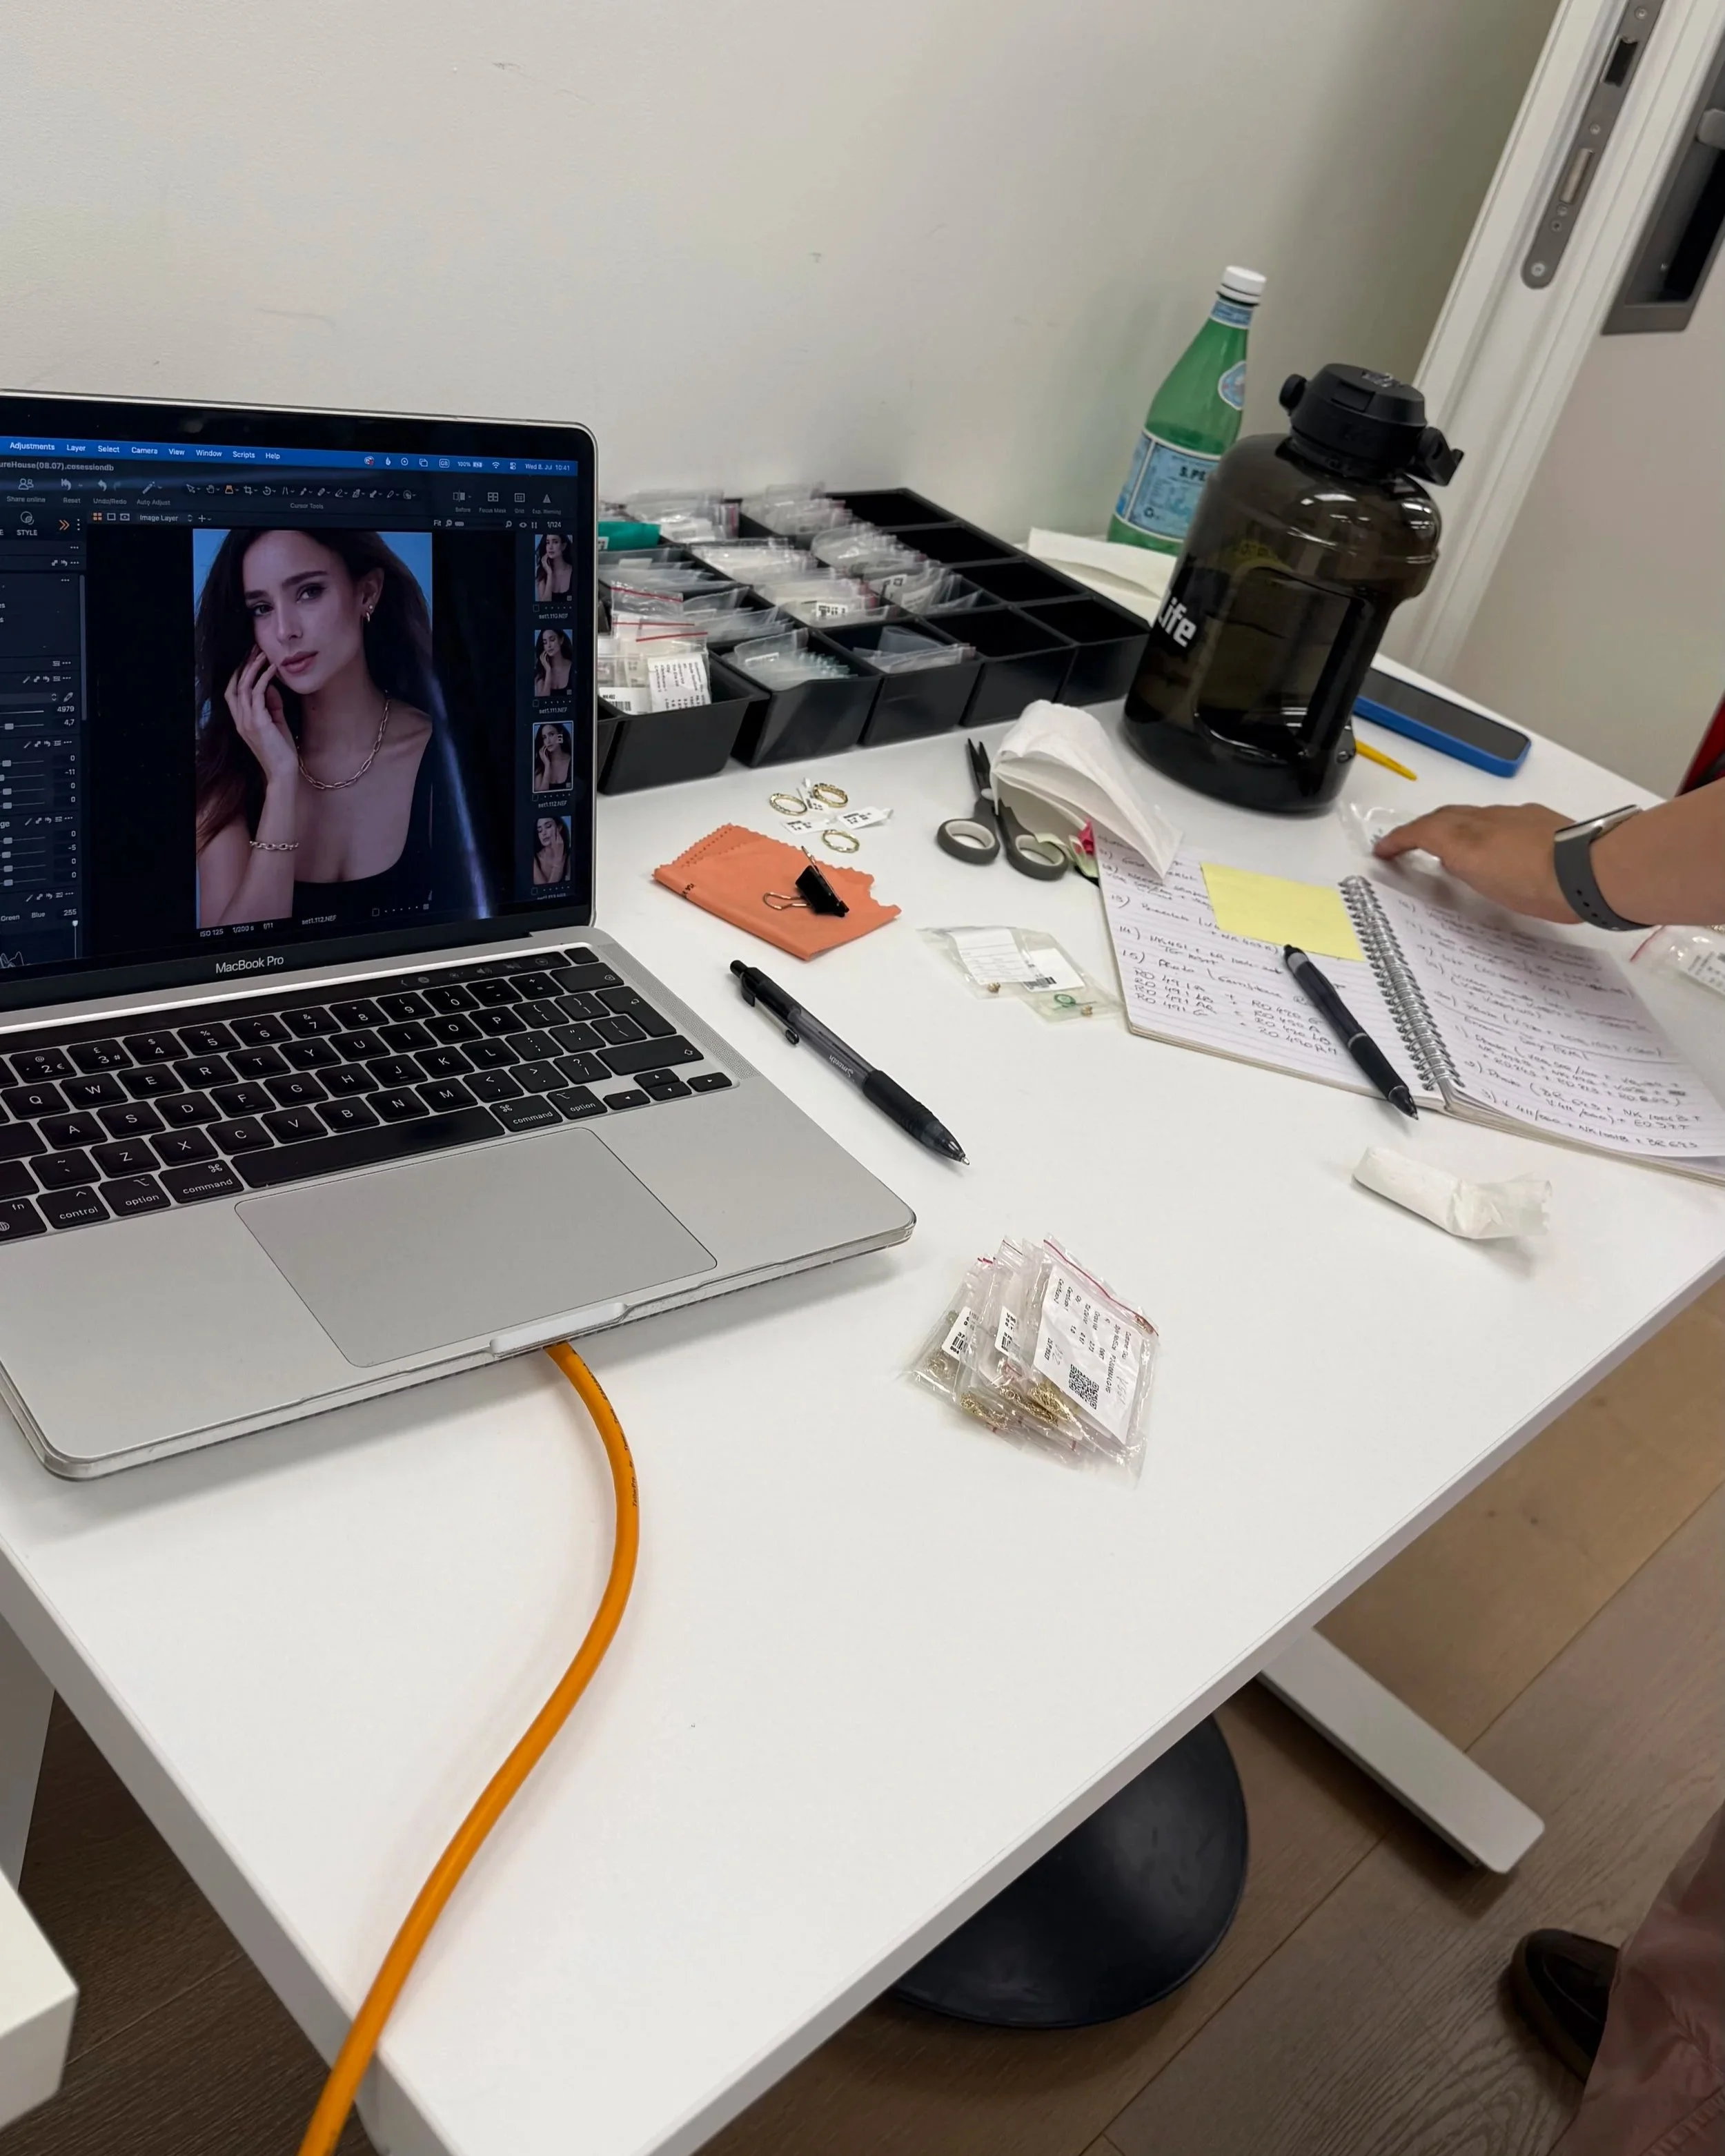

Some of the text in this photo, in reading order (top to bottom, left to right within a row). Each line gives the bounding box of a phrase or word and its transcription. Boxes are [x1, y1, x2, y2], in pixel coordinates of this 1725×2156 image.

[10, 442, 55, 451] Adjustments
[98, 445, 119, 453] Select
[131, 447, 158, 455] Camera
[233, 451, 255, 459] Scripts
[266, 452, 280, 460] Help
[215, 955, 284, 974] MacBook Pro
[208, 1038, 217, 1046] 5
[259, 1030, 270, 1038] 6
[29, 1095, 43, 1105] Q
[85, 1085, 101, 1095] W
[145, 1077, 157, 1086] E
[199, 1067, 212, 1075] R
[253, 1057, 263, 1066] T
[353, 1041, 366, 1049] U
[492, 1017, 501, 1025] P
[41, 1064, 52, 1073] 2
[99, 1055, 110, 1064] 3
[829, 1055, 854, 1078] Smooth
[69, 1125, 80, 1135] A
[126, 1115, 137, 1124] S
[181, 1104, 194, 1113] D
[237, 1094, 247, 1102] F
[290, 1084, 302, 1093] G
[341, 1075, 354, 1084] H
[395, 1066, 402, 1074] J
[438, 1057, 450, 1066] K
[570, 1101, 595, 1113] option
[119, 1153, 133, 1162] Z
[177, 1141, 192, 1150] X
[235, 1130, 247, 1139] C
[288, 1119, 299, 1128] V
[341, 1110, 353, 1118] B
[391, 1099, 406, 1108] N
[440, 1090, 454, 1099] M
[513, 1110, 553, 1125] command
[183, 1179, 233, 1195] command
[12, 1202, 25, 1211] fn
[125, 1193, 159, 1207] option
[59, 1206, 98, 1219] control
